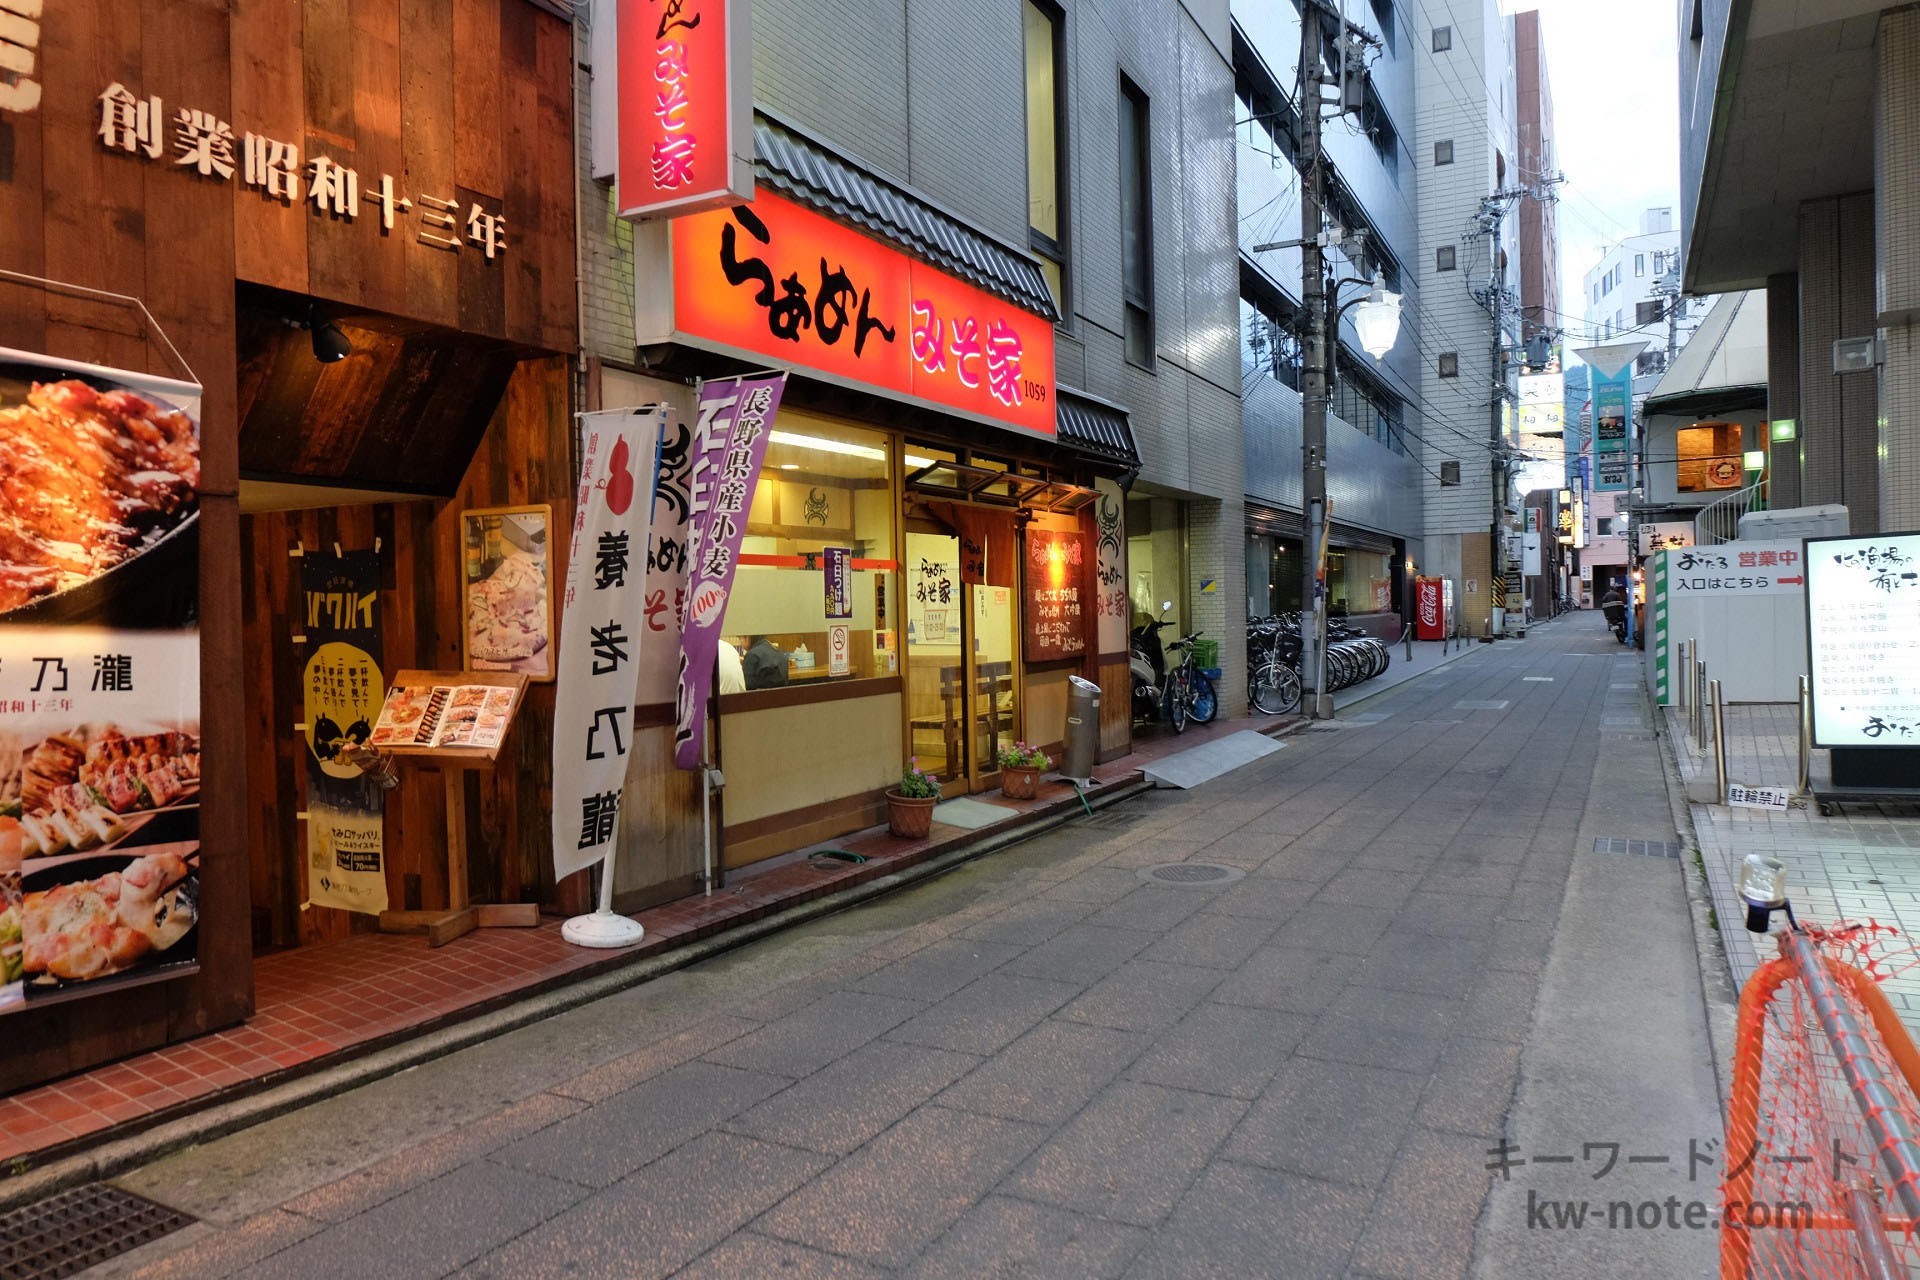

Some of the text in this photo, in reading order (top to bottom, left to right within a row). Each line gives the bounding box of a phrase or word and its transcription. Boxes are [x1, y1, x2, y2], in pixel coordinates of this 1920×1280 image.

[651, 41, 697, 191] みそ家
[97, 81, 508, 260] 創業昭和十三年
[720, 205, 1024, 407] らぁめん みそ家
[1024, 379, 1047, 404] 1059
[701, 385, 773, 581] 長野県産小麦
[1677, 550, 1798, 571] おたる 営業中
[916, 578, 951, 604] みそ家
[1677, 576, 1769, 591] 入口はこちら
[305, 590, 377, 630] バクハイ
[690, 585, 728, 620] 100%
[0, 653, 133, 692] 乃瀧
[1861, 715, 1920, 738] おた
[1731, 788, 1786, 807] 駐輪禁止
